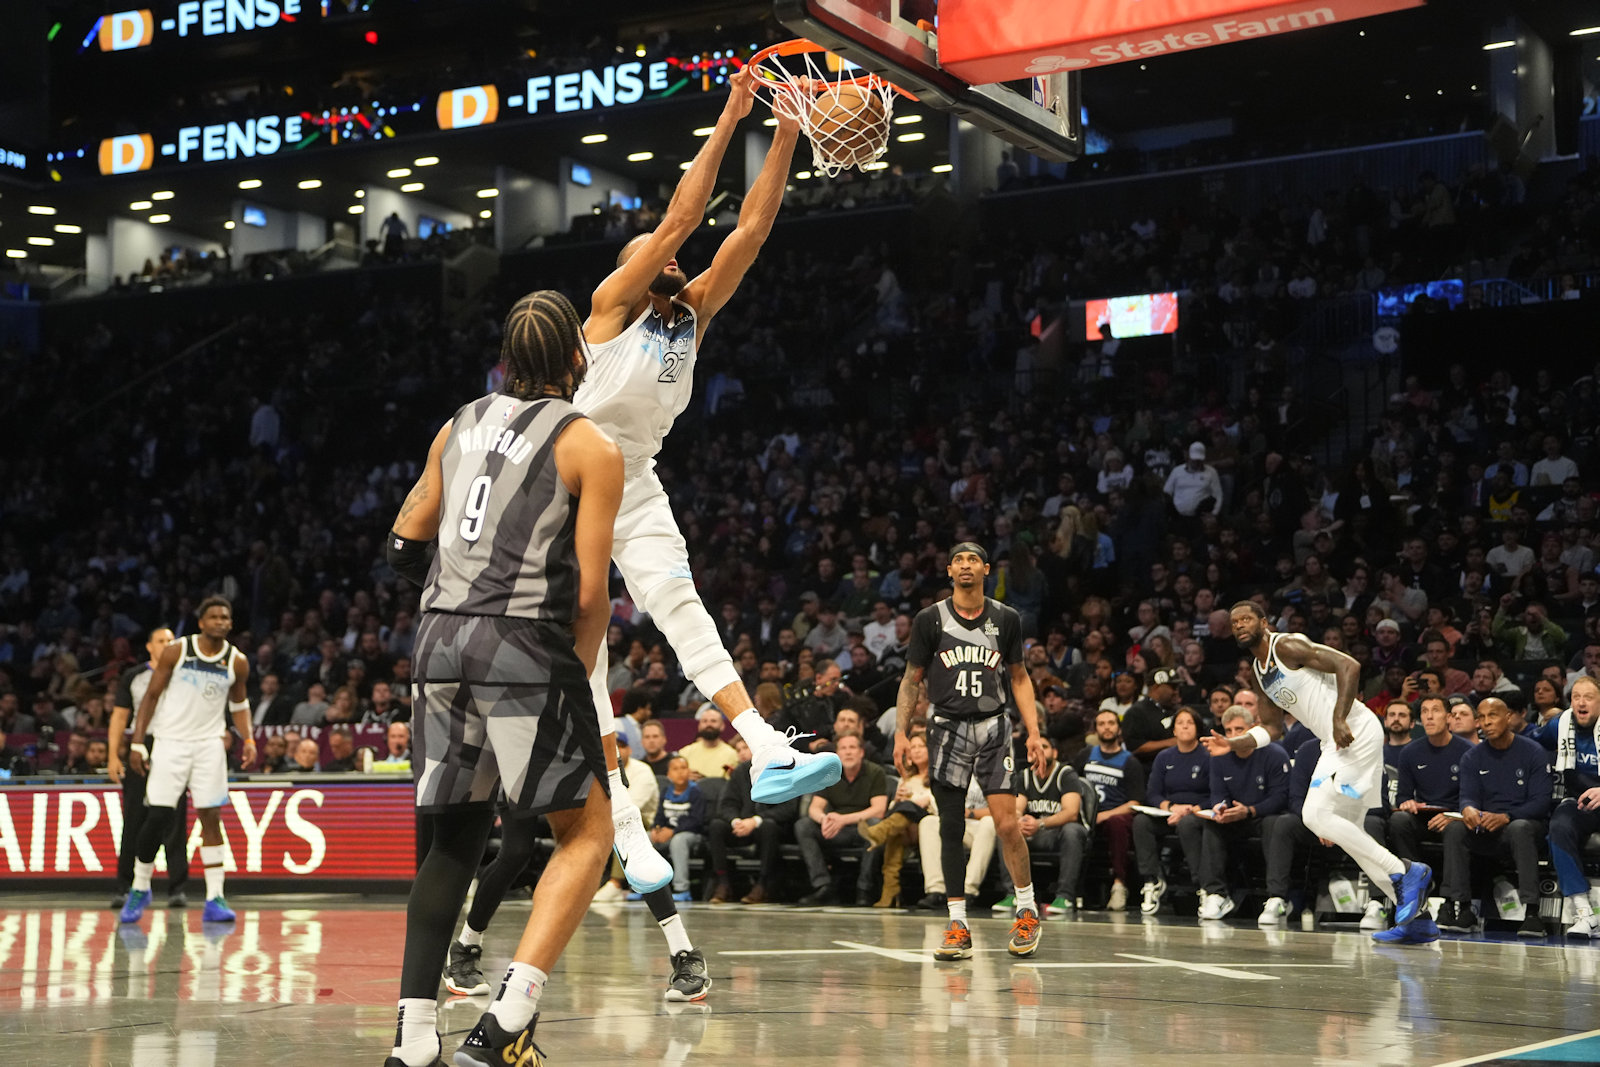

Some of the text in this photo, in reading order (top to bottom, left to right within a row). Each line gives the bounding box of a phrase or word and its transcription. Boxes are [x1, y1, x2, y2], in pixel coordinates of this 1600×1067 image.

[111, 10, 145, 50] D
[451, 86, 488, 129] D
[111, 133, 146, 175] D
[457, 424, 534, 466] WATFORD
[459, 475, 493, 543] 9
[939, 645, 1002, 670] BROOKLYN
[954, 669, 983, 698] 45
[0, 789, 327, 875] AIRAYS
